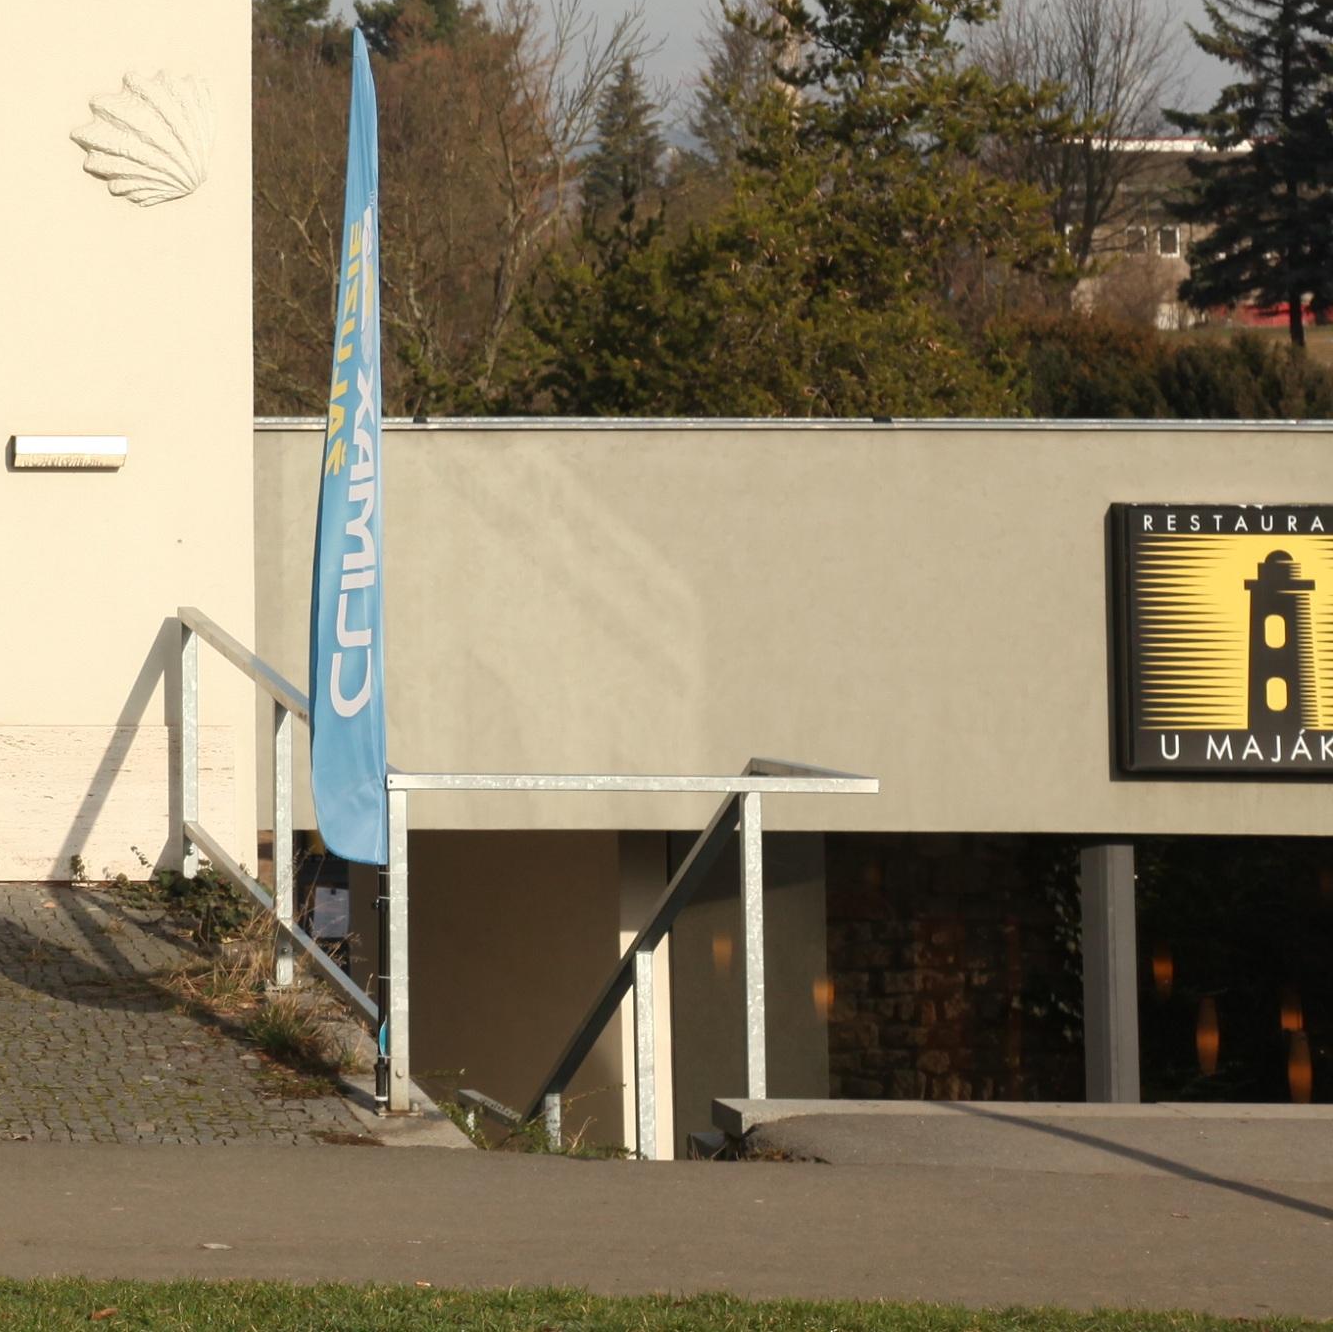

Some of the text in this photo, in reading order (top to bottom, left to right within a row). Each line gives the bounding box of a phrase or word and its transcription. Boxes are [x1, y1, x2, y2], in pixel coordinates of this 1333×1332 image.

[1142, 514, 1325, 532] RESTAURA
[1160, 728, 1333, 763] U MAJÁK
